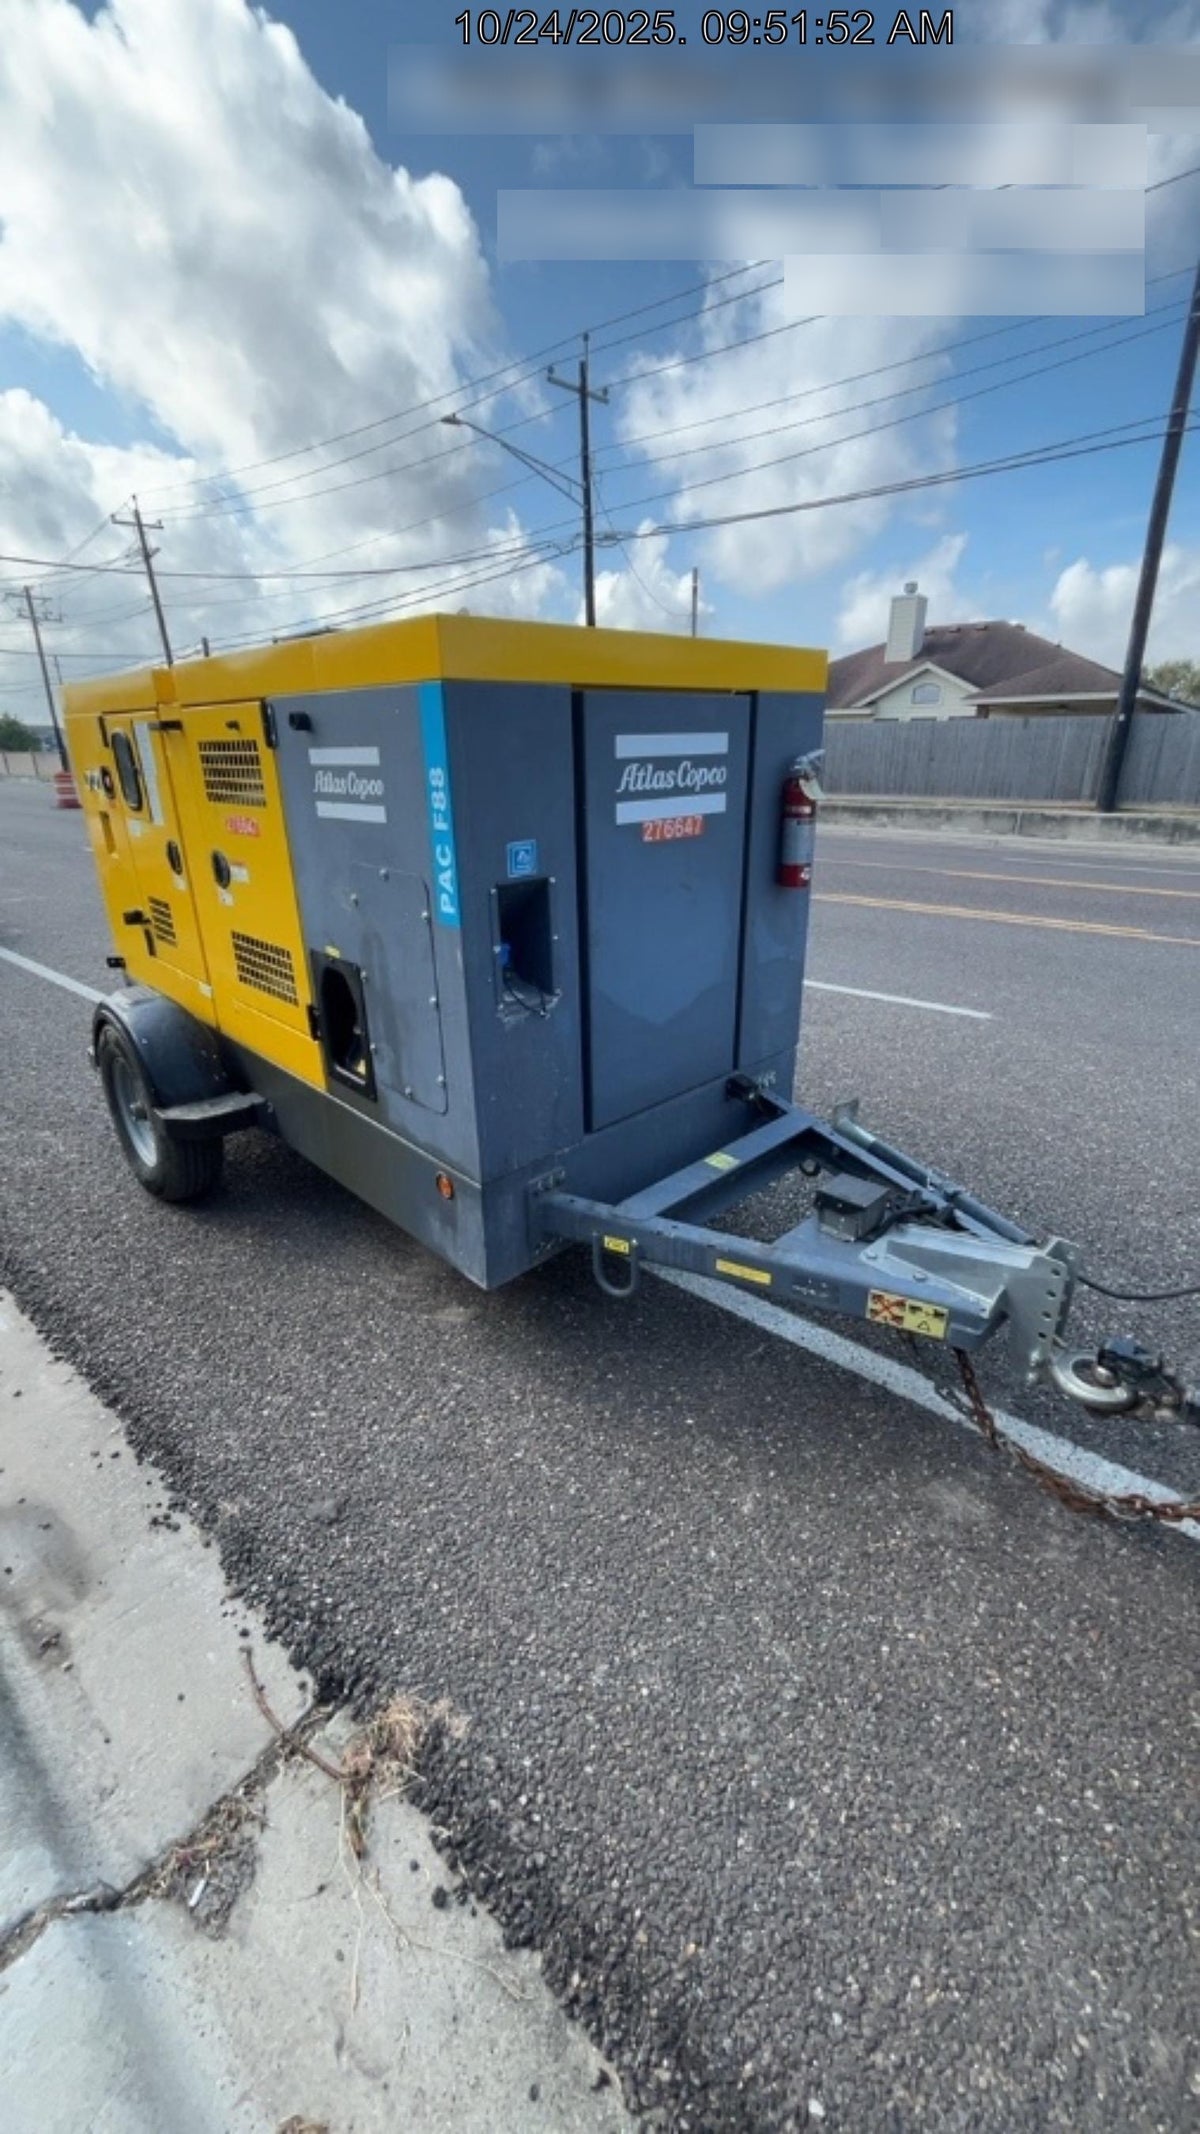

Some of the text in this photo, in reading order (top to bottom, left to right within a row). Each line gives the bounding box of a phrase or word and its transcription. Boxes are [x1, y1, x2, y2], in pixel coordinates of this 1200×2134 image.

[313, 770, 384, 799] Atlas Copco
[616, 761, 727, 792] Atlas Copco
[429, 767, 456, 914] PAC F88
